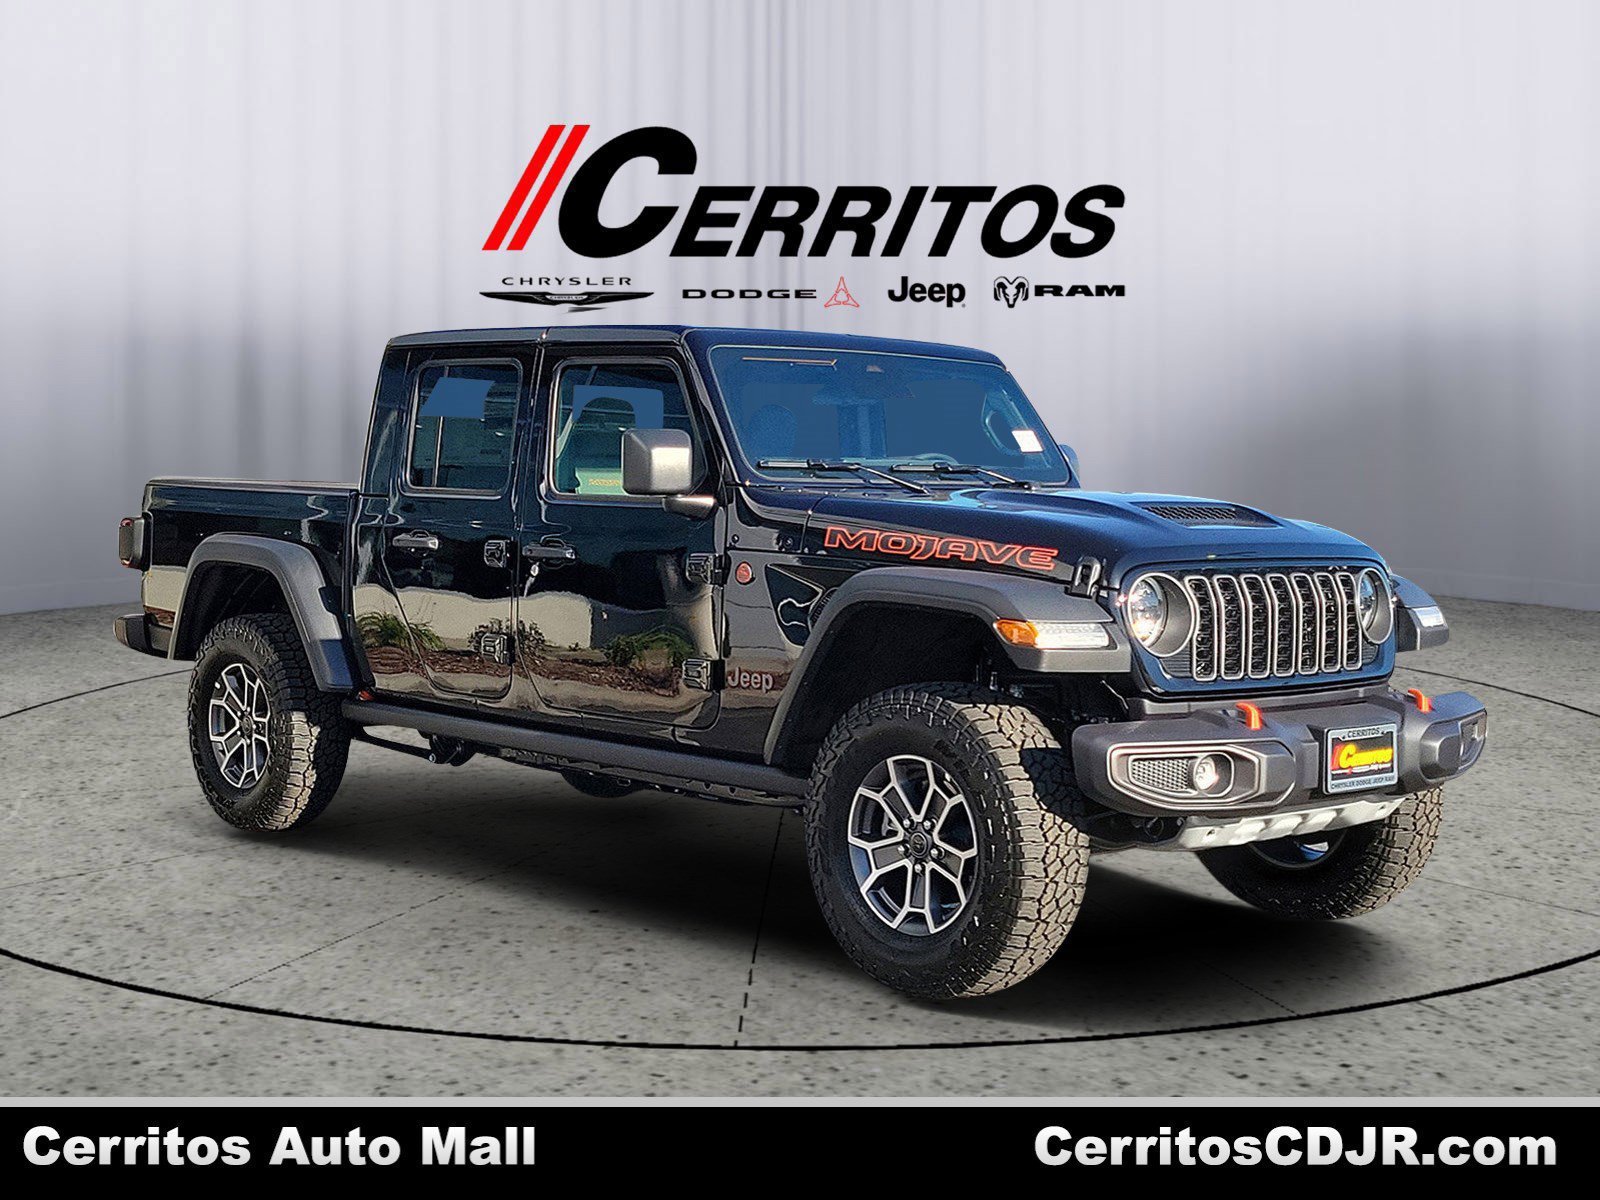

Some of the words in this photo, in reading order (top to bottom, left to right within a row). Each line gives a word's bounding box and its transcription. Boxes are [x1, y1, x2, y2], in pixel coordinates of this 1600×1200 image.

[824, 525, 1059, 571] MOJAVE
[727, 666, 774, 693] Jeep
[1347, 727, 1380, 738] CERRITOS
